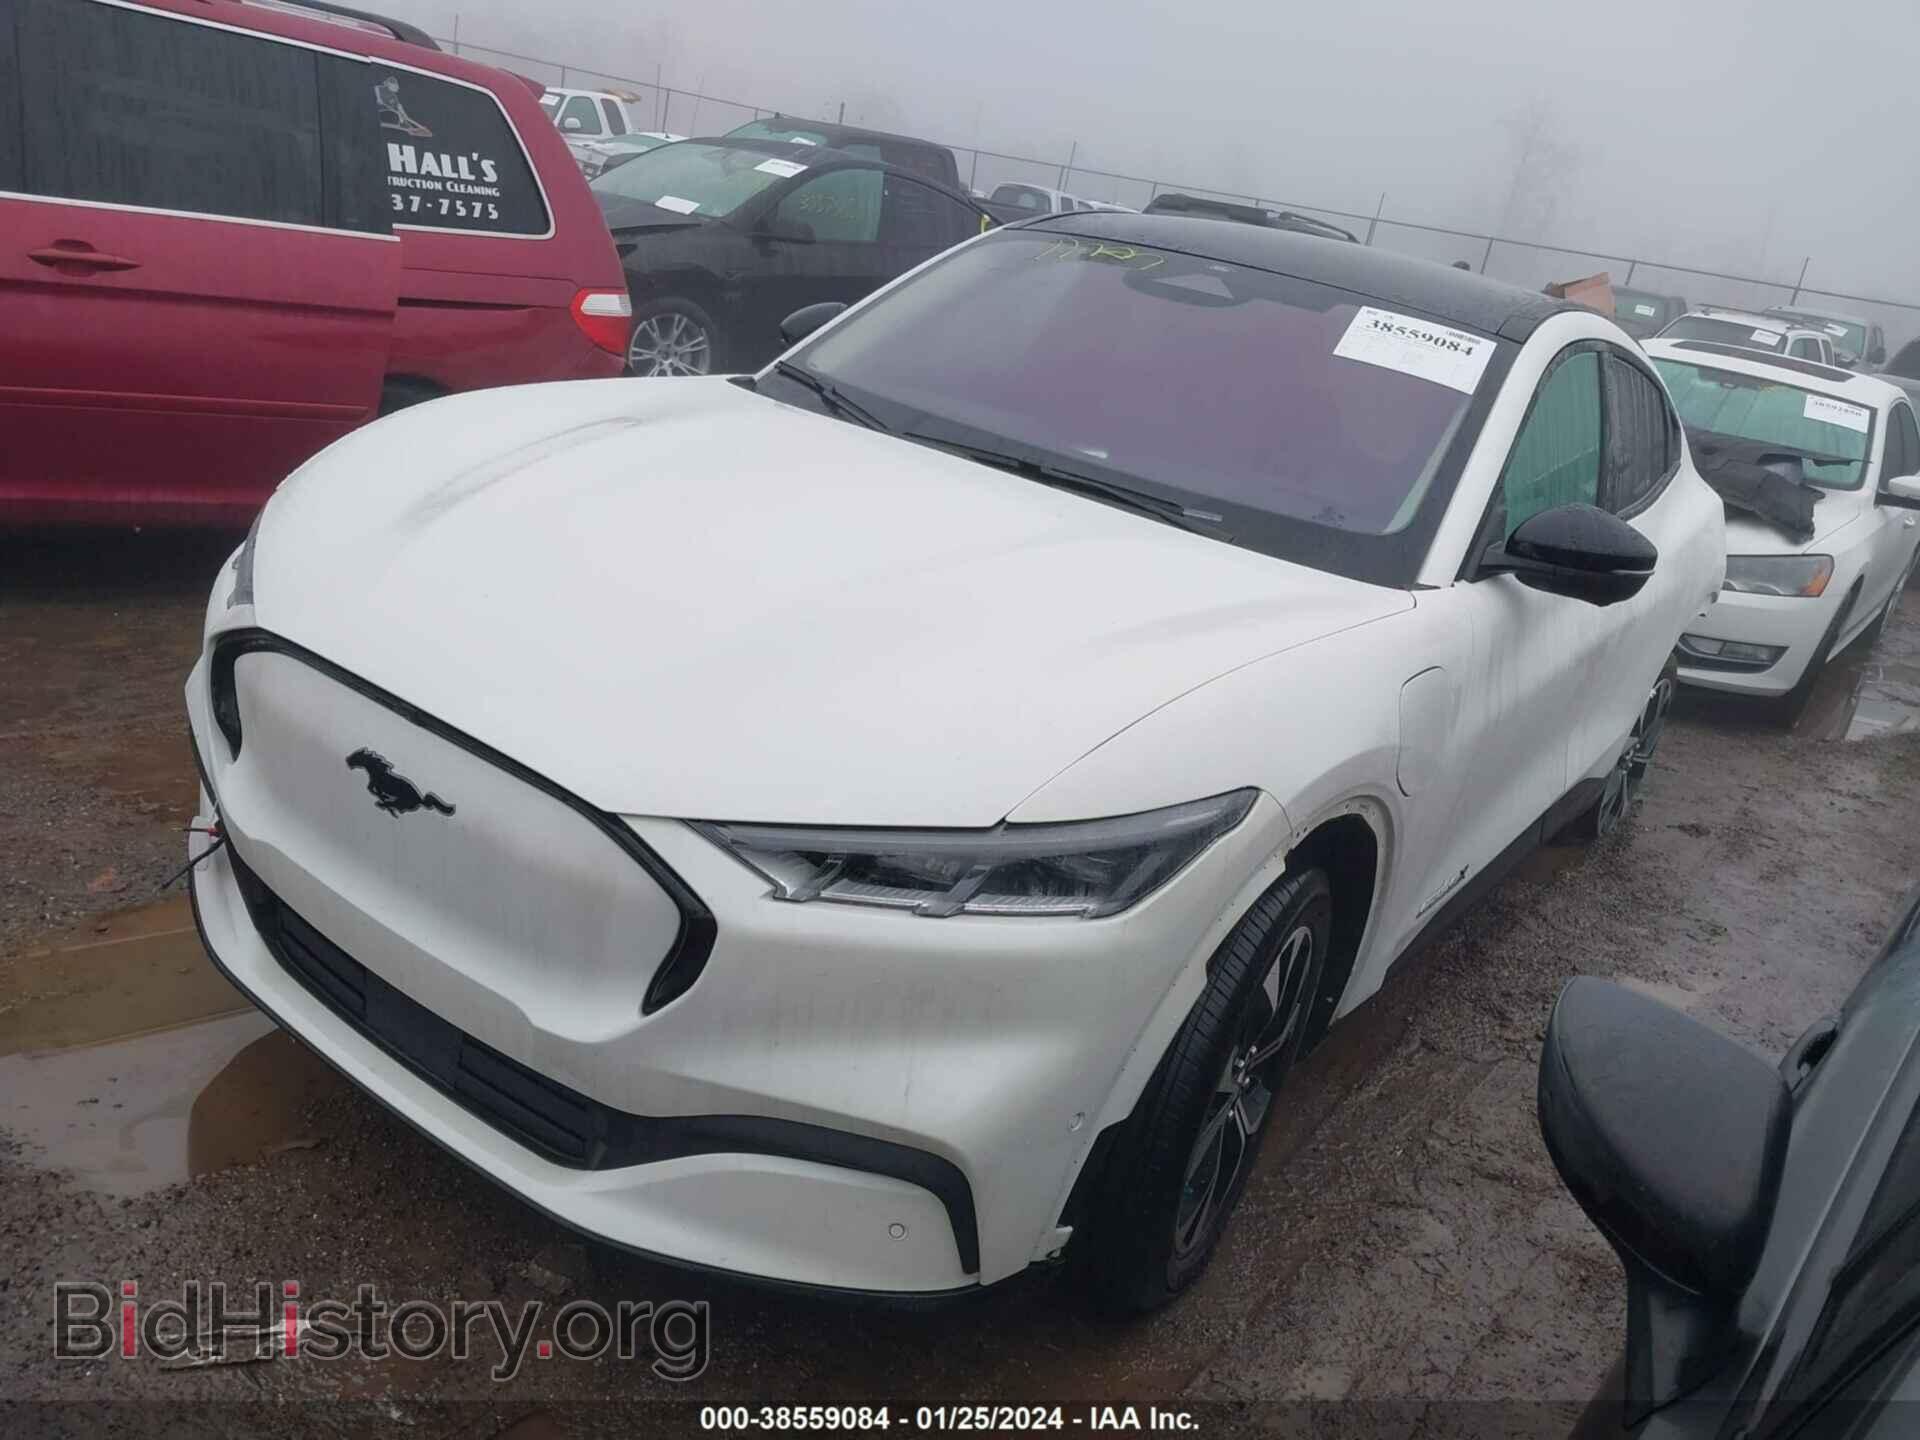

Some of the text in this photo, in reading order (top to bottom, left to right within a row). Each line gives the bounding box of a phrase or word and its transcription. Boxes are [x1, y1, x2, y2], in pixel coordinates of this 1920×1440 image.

[387, 143, 498, 183] HALL'S
[446, 180, 500, 197] CLEANING
[1366, 319, 1474, 357] 38559084
